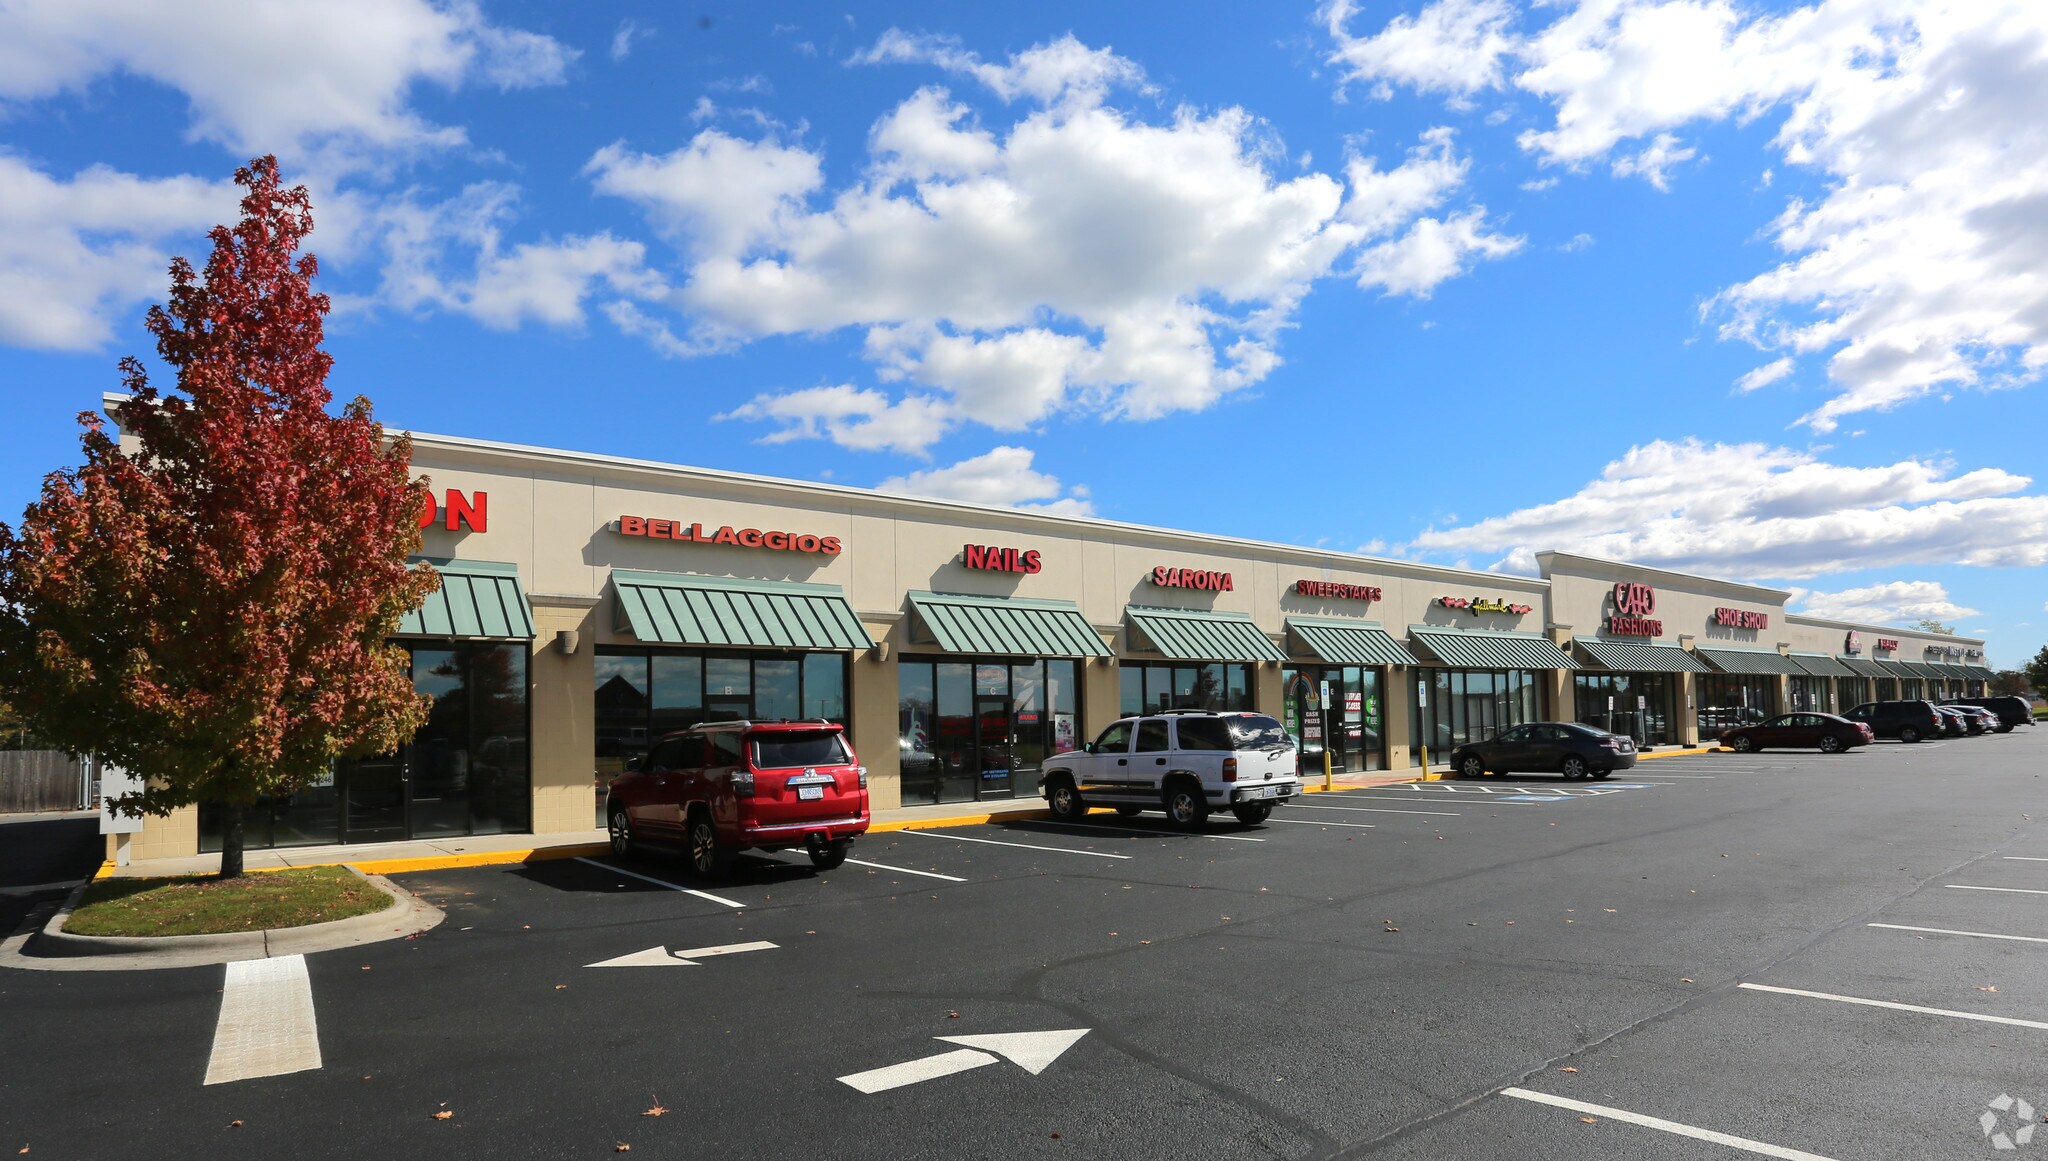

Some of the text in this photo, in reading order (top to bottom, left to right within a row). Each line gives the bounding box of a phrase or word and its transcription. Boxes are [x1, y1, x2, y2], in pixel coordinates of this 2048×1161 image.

[620, 514, 842, 555] BELLAGGIOS
[963, 543, 1042, 574] NAILS
[1152, 565, 1234, 592] SARONA
[1297, 579, 1382, 602] SWEEPSTAKES
[1614, 581, 1656, 616] CATO
[1473, 597, 1508, 617] Hallmark
[1715, 607, 1769, 630] SHOE SHOW
[1610, 616, 1663, 637] FASHIONS
[724, 686, 733, 695] B
[990, 687, 996, 695] C
